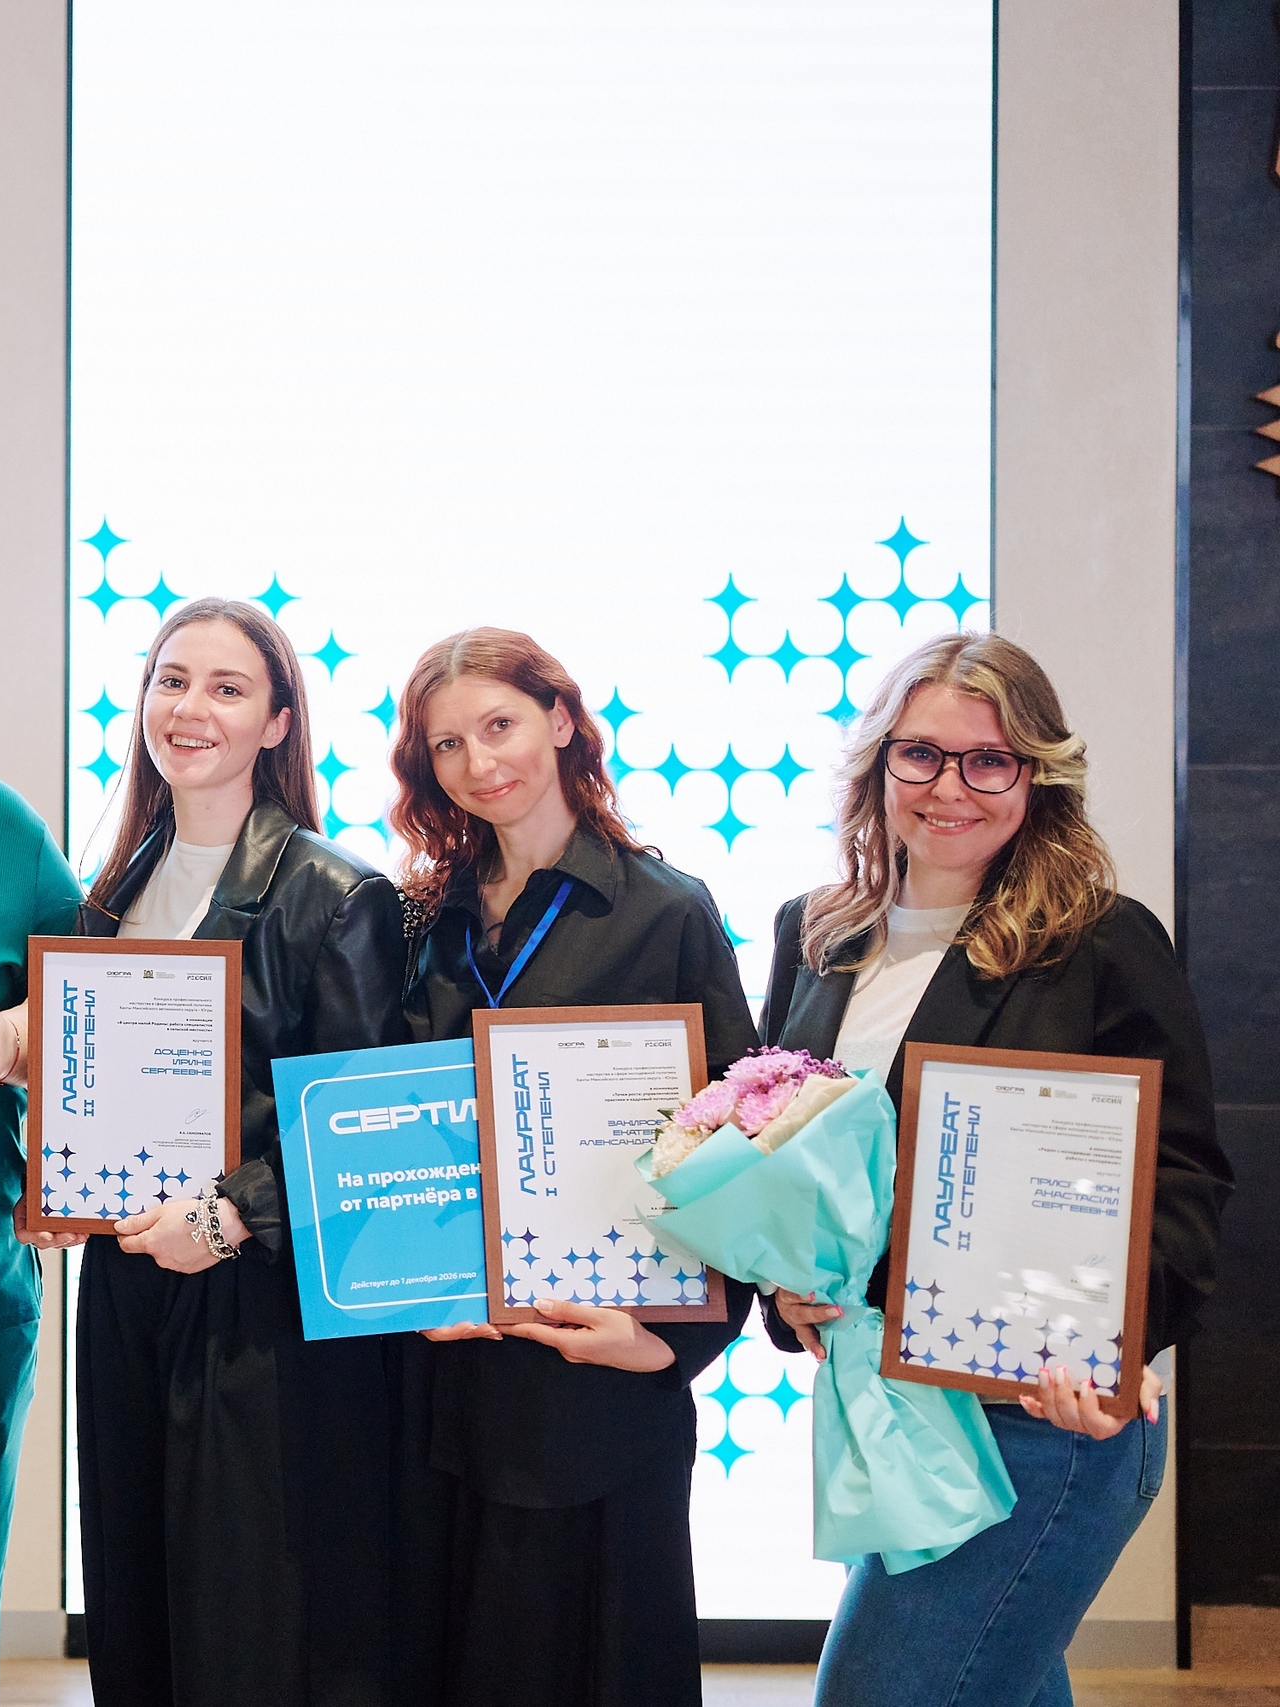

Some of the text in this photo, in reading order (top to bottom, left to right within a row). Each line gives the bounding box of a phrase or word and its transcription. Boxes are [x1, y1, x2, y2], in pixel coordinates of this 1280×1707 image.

[62, 980, 78, 1115] ЛАУРЕАТ
[84, 989, 96, 1117] II СТЕПЕНИ
[154, 1049, 212, 1057] ДОЦЕНКО
[141, 1067, 212, 1076] СЕРГЕЕВНЕ
[329, 1098, 478, 1135] СЕРТИ
[511, 1054, 538, 1196] ЛАУРЕАТ
[608, 1119, 666, 1127] ЗАКИРОВ
[537, 1071, 557, 1197] I СТЕПЕНИ
[579, 1138, 657, 1147] АЛЕКСАНДРО
[337, 1163, 481, 1188] На прохожден
[932, 1092, 961, 1247] ЛАУРЕАТ
[957, 1105, 981, 1251] II СТЕПЕНИ
[340, 1187, 477, 1212] от партнёра в
[1032, 1200, 1118, 1217] СЕРГЕЕВНЕ
[1034, 1189, 1119, 1206] АНАСТАСИИ
[350, 1280, 388, 1290] Действует
[405, 1275, 438, 1285] декабря
[439, 1272, 457, 1281] 2026
[459, 1271, 477, 1280] года
